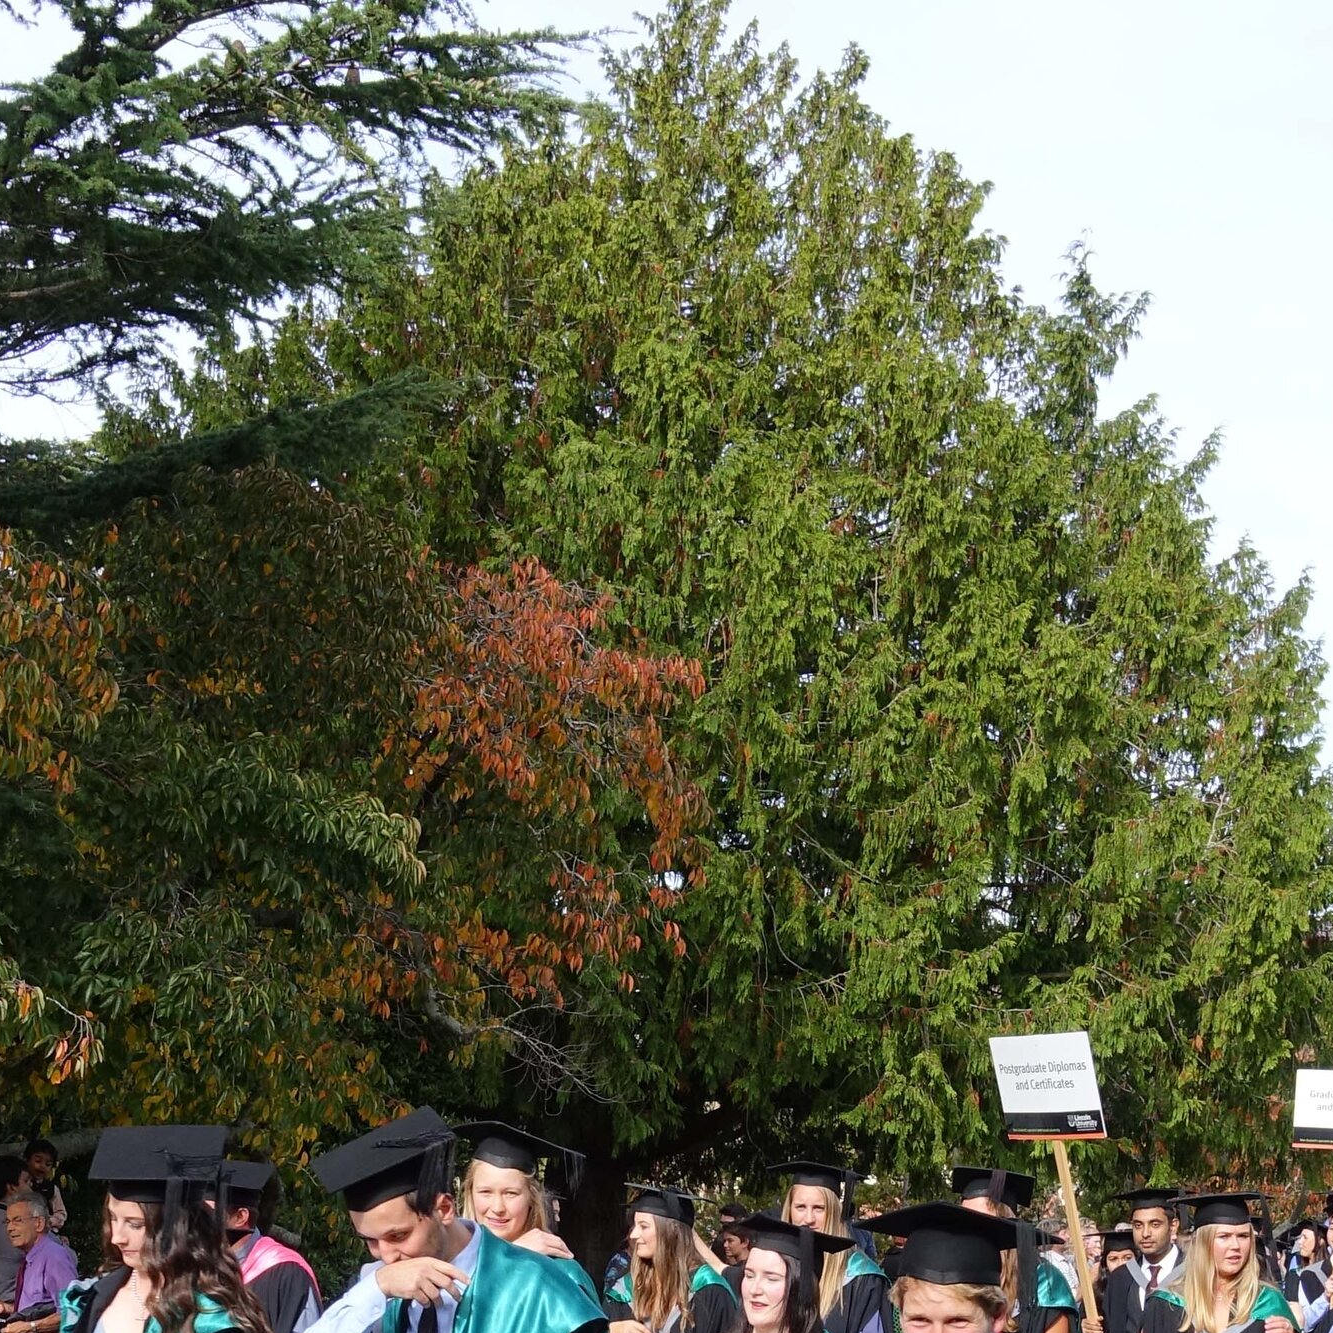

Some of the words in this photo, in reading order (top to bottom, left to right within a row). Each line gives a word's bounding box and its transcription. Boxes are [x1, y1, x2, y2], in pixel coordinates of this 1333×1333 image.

[999, 1063, 1047, 1076] Postgraduate
[1048, 1061, 1087, 1075] Diplomas
[1015, 1079, 1030, 1091] and
[1030, 1078, 1075, 1091] Certificates
[1316, 1103, 1333, 1112] and
